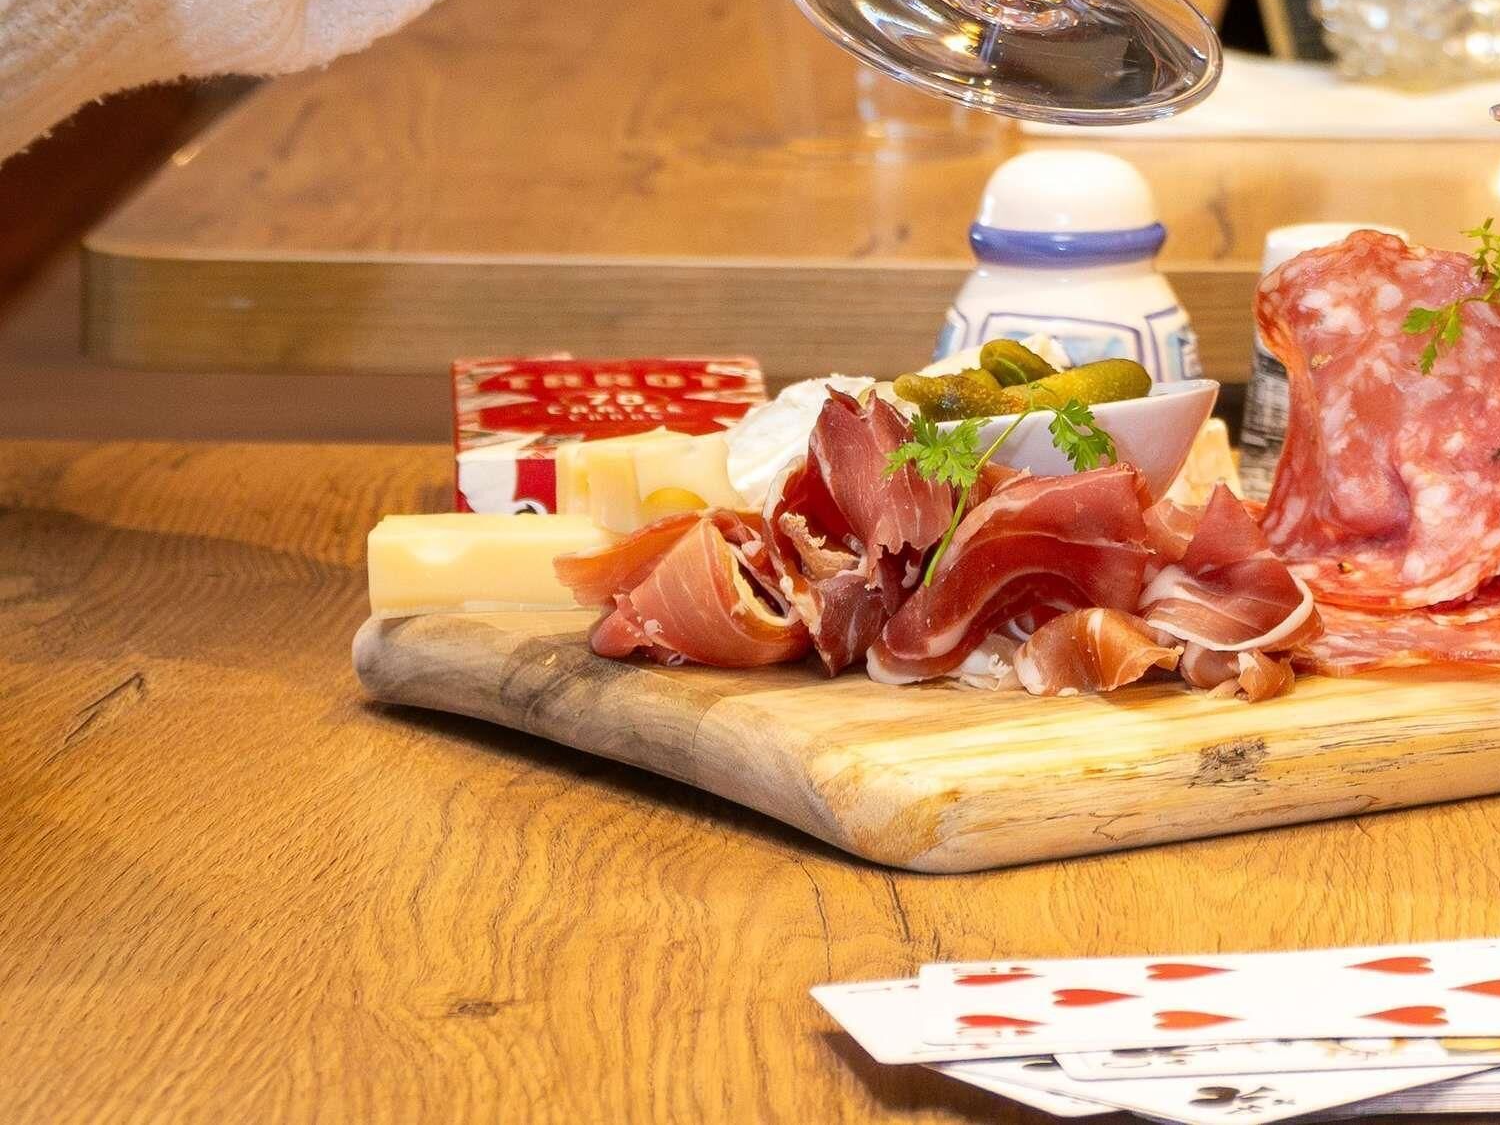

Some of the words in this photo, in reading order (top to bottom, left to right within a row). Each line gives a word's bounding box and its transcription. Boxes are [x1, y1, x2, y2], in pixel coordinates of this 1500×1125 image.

[500, 372, 724, 391] TAROT
[586, 390, 647, 407] 78
[546, 402, 683, 416] CARTES
